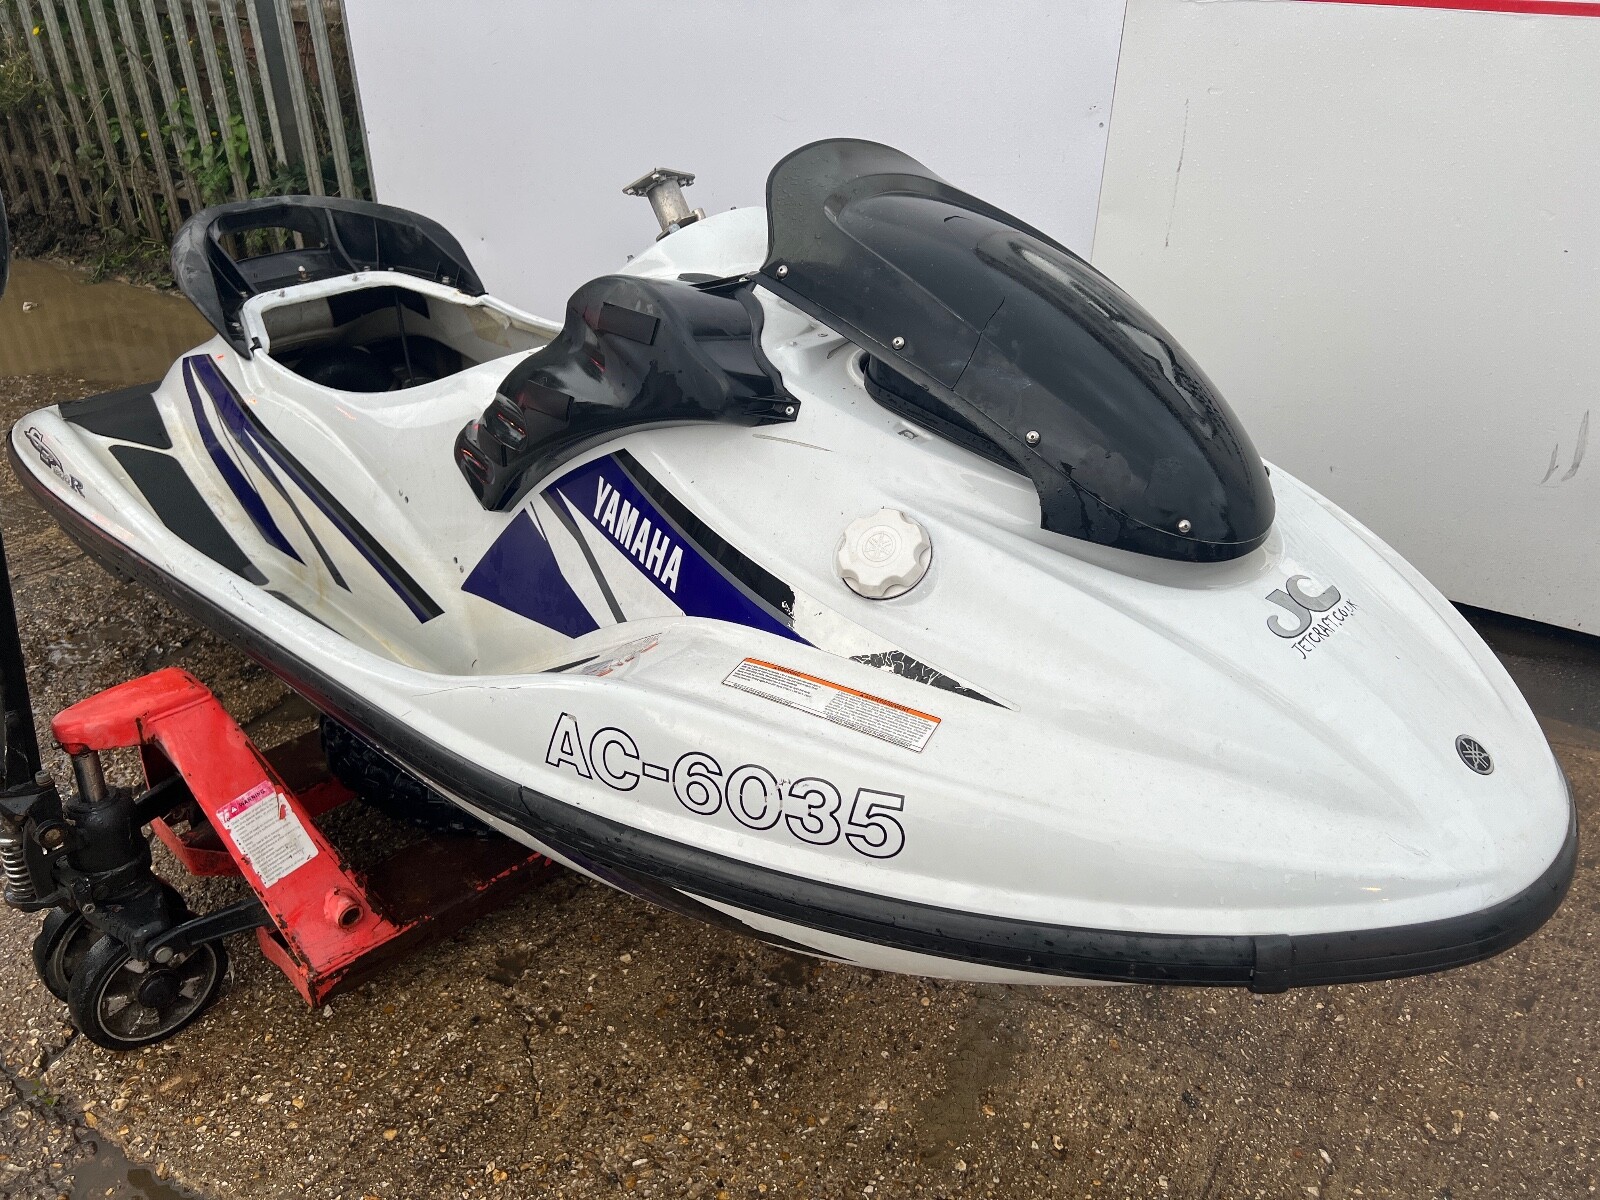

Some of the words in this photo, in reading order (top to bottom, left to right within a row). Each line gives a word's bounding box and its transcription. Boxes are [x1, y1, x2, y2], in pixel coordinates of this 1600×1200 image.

[593, 476, 684, 594] YAMAHA
[239, 788, 266, 807] WARNING
[545, 712, 905, 859] AC-6035
